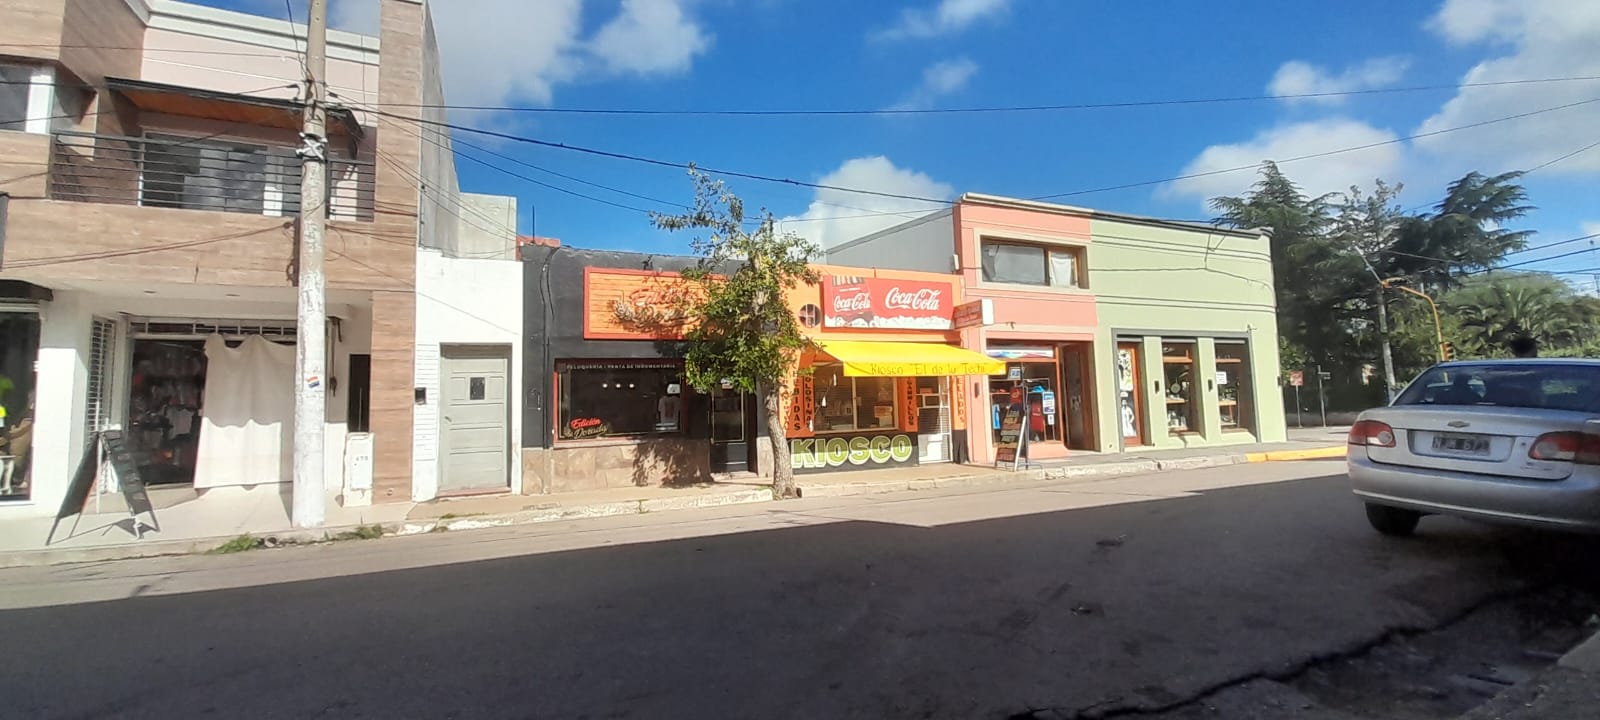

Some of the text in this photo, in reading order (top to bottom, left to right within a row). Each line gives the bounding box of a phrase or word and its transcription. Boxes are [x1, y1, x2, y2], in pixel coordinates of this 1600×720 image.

[833, 292, 871, 312] Coca-Cola
[885, 287, 942, 310] Coca-Cola
[871, 363, 903, 375] Kiosco
[931, 363, 944, 374] de
[957, 377, 966, 424] ELADOS
[791, 434, 912, 468] KIOSCO
